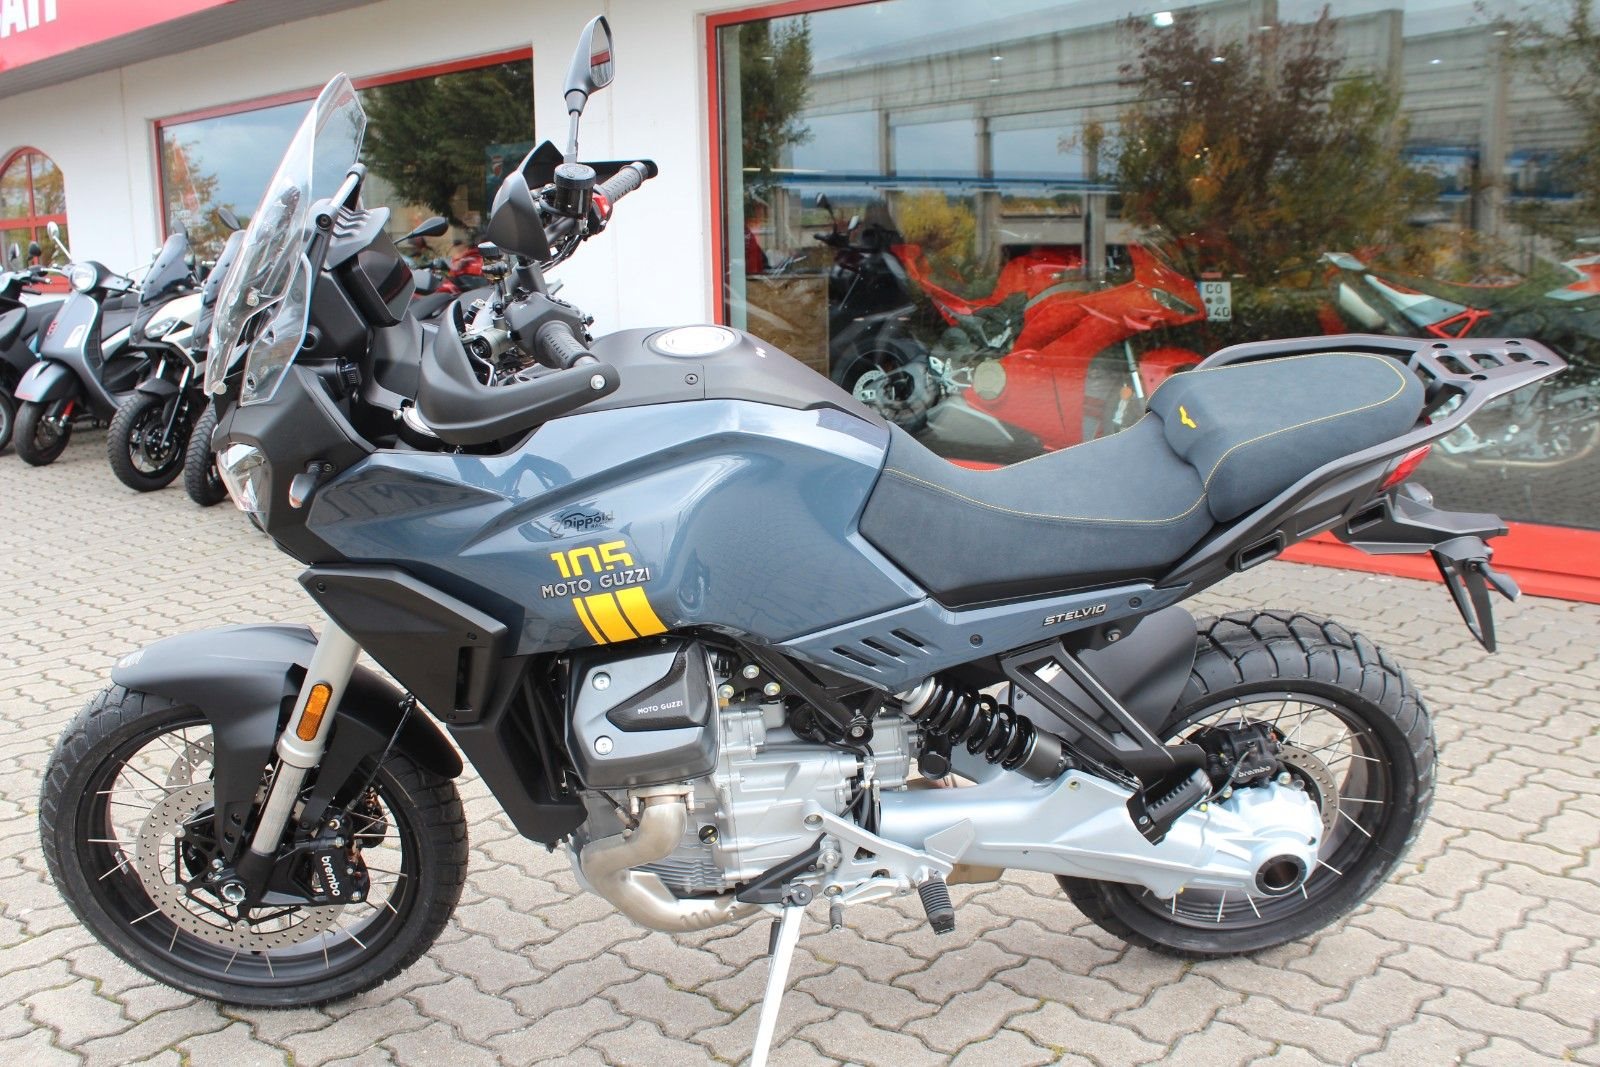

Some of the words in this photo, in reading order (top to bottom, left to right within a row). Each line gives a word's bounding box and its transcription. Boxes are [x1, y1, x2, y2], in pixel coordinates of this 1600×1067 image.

[541, 579, 592, 599] MOTO
[599, 567, 651, 589] GUZZI
[1043, 603, 1107, 626] STELVIO
[637, 705, 659, 715] MOTO
[660, 700, 683, 710] GUZZI
[1238, 765, 1271, 778] brembo
[321, 855, 341, 896] brembo
